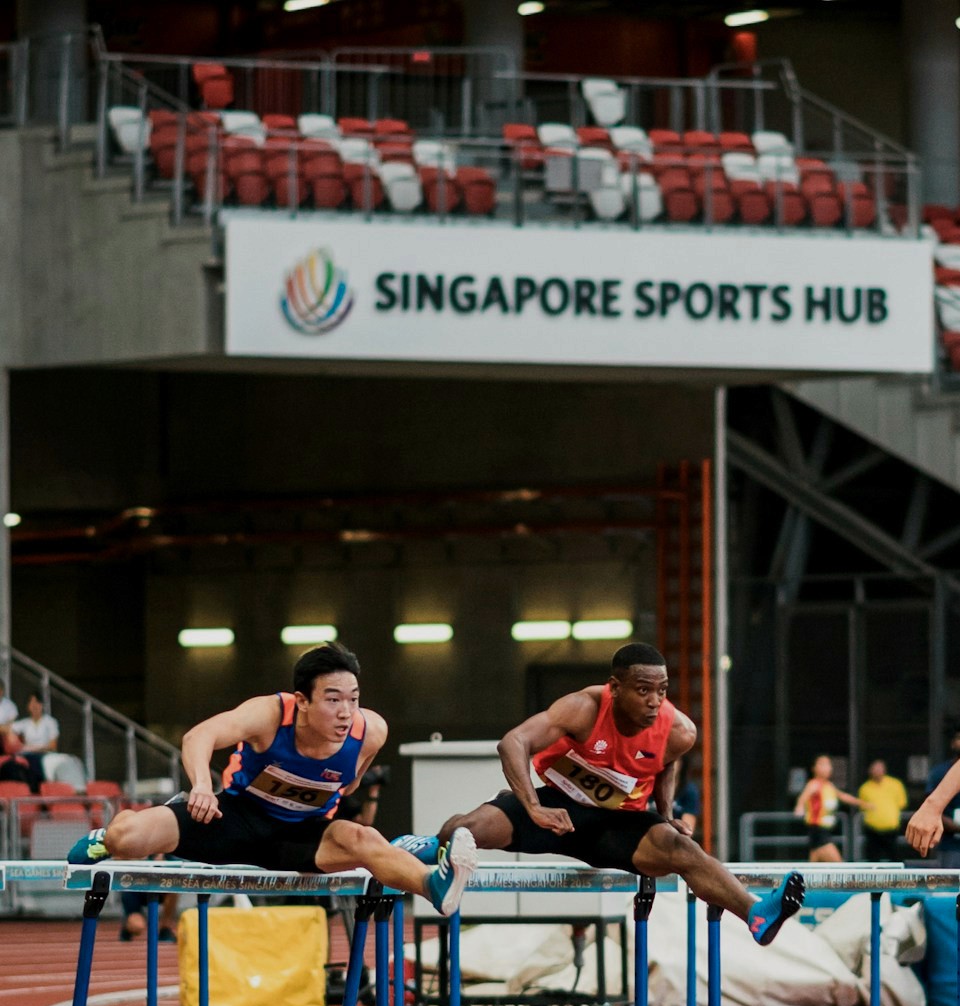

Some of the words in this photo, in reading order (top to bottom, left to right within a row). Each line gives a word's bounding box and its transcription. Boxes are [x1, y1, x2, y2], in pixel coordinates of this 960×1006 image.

[375, 272, 622, 318] SINGAPORE
[634, 280, 793, 323] SPORTS
[804, 285, 889, 325] HUB
[568, 764, 615, 802] 180
[182, 879, 200, 889] SEA
[202, 879, 237, 890] GAMES
[515, 879, 569, 889] SINGAPORE
